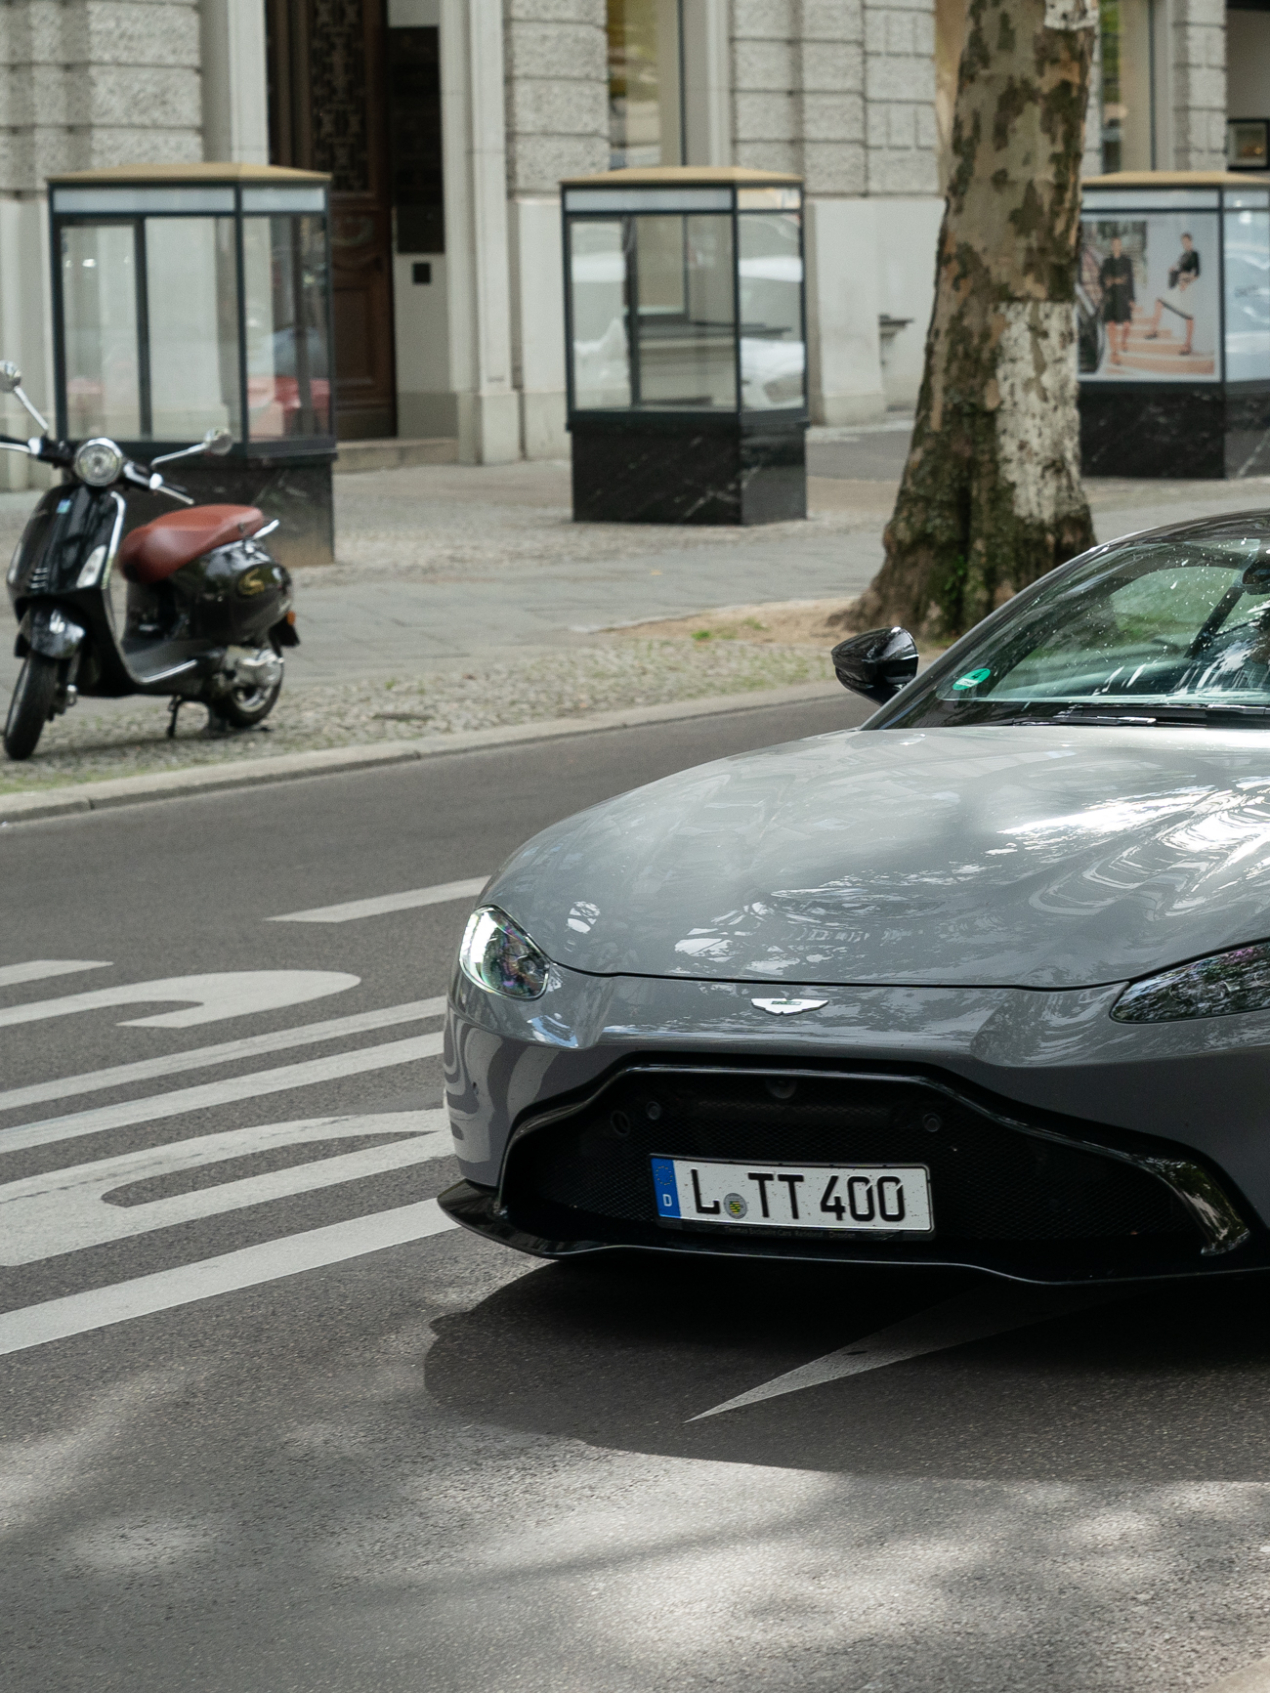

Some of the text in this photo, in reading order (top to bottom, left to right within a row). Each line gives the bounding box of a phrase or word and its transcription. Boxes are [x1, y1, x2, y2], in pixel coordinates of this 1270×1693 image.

[662, 1193, 673, 1207] D
[690, 1168, 906, 1222] L TT 400
